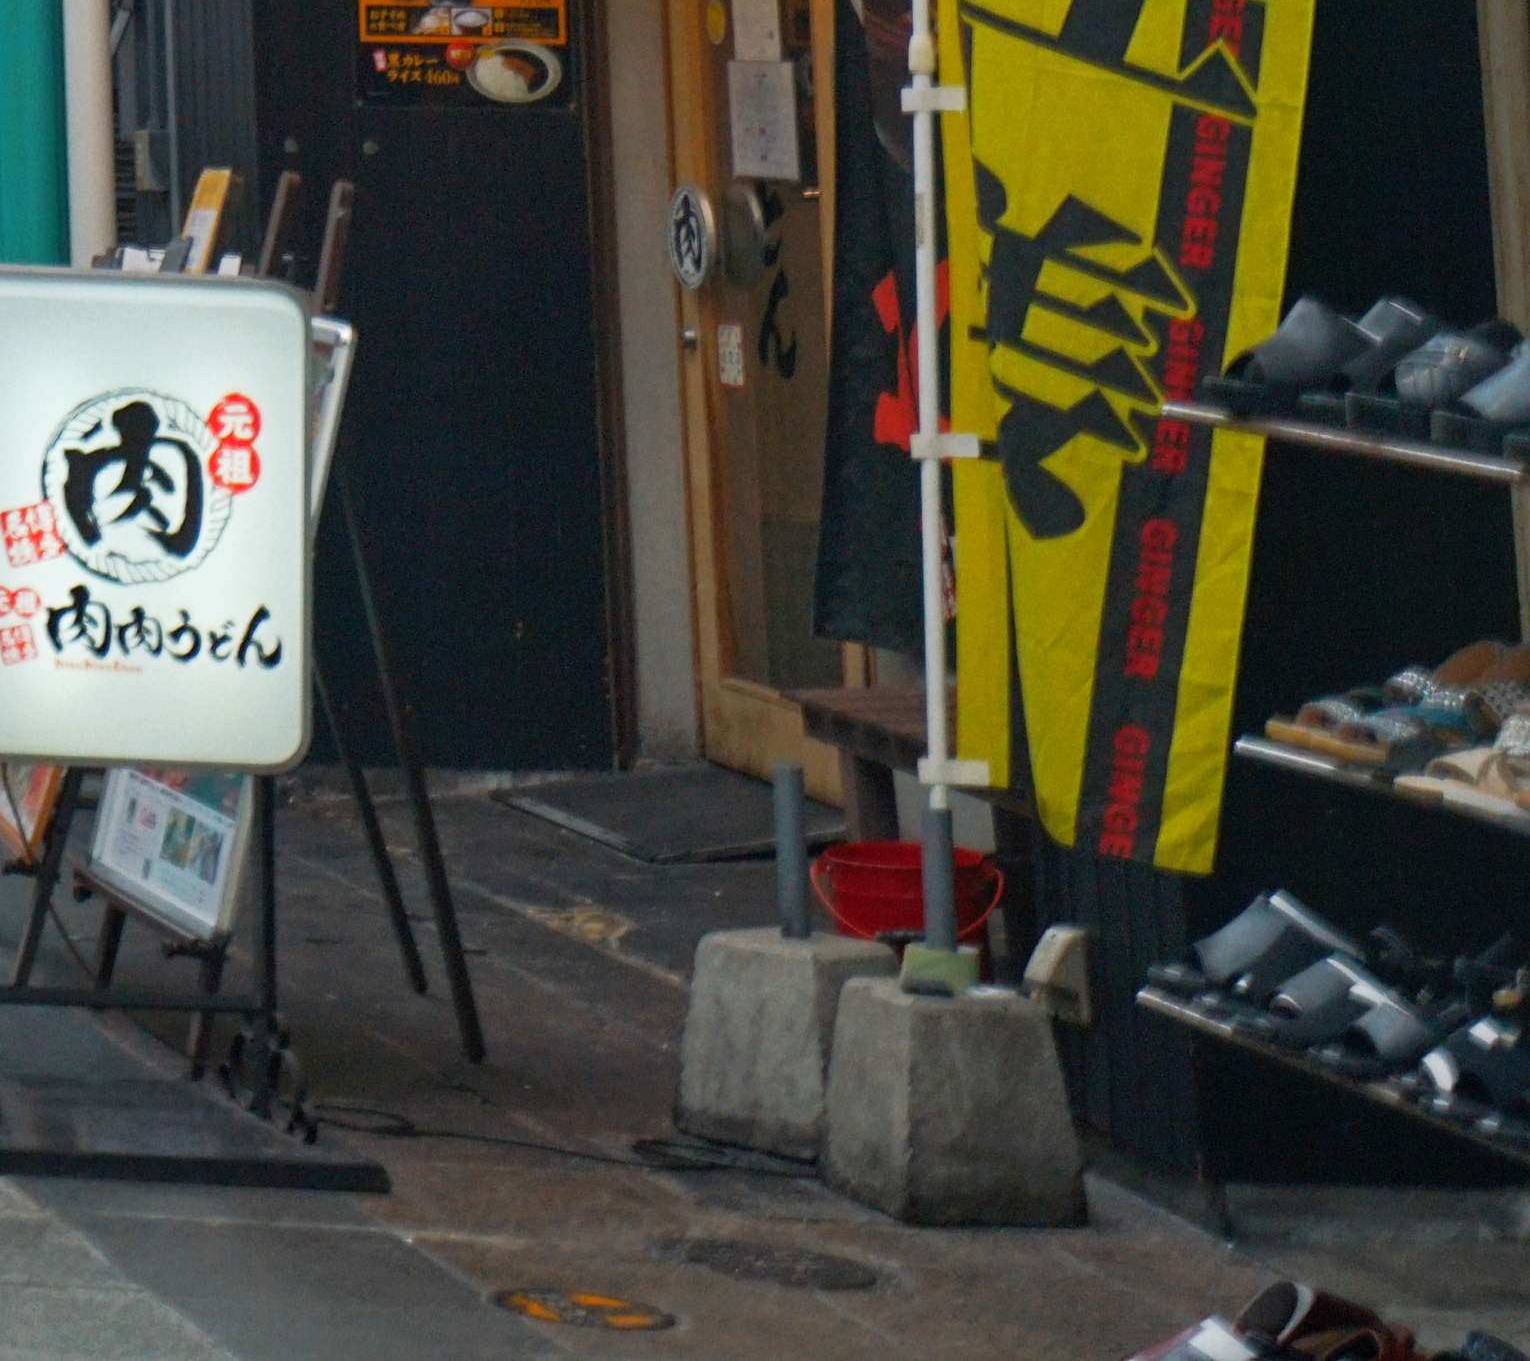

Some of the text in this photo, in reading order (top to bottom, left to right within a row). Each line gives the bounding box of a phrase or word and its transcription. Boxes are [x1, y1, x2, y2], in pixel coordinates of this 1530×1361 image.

[1180, 113, 1231, 269] GINGER
[64, 400, 202, 558] 肉
[214, 399, 257, 487] 元祖
[45, 585, 284, 670] 肉肉うどん
[1123, 516, 1180, 679] GINGER
